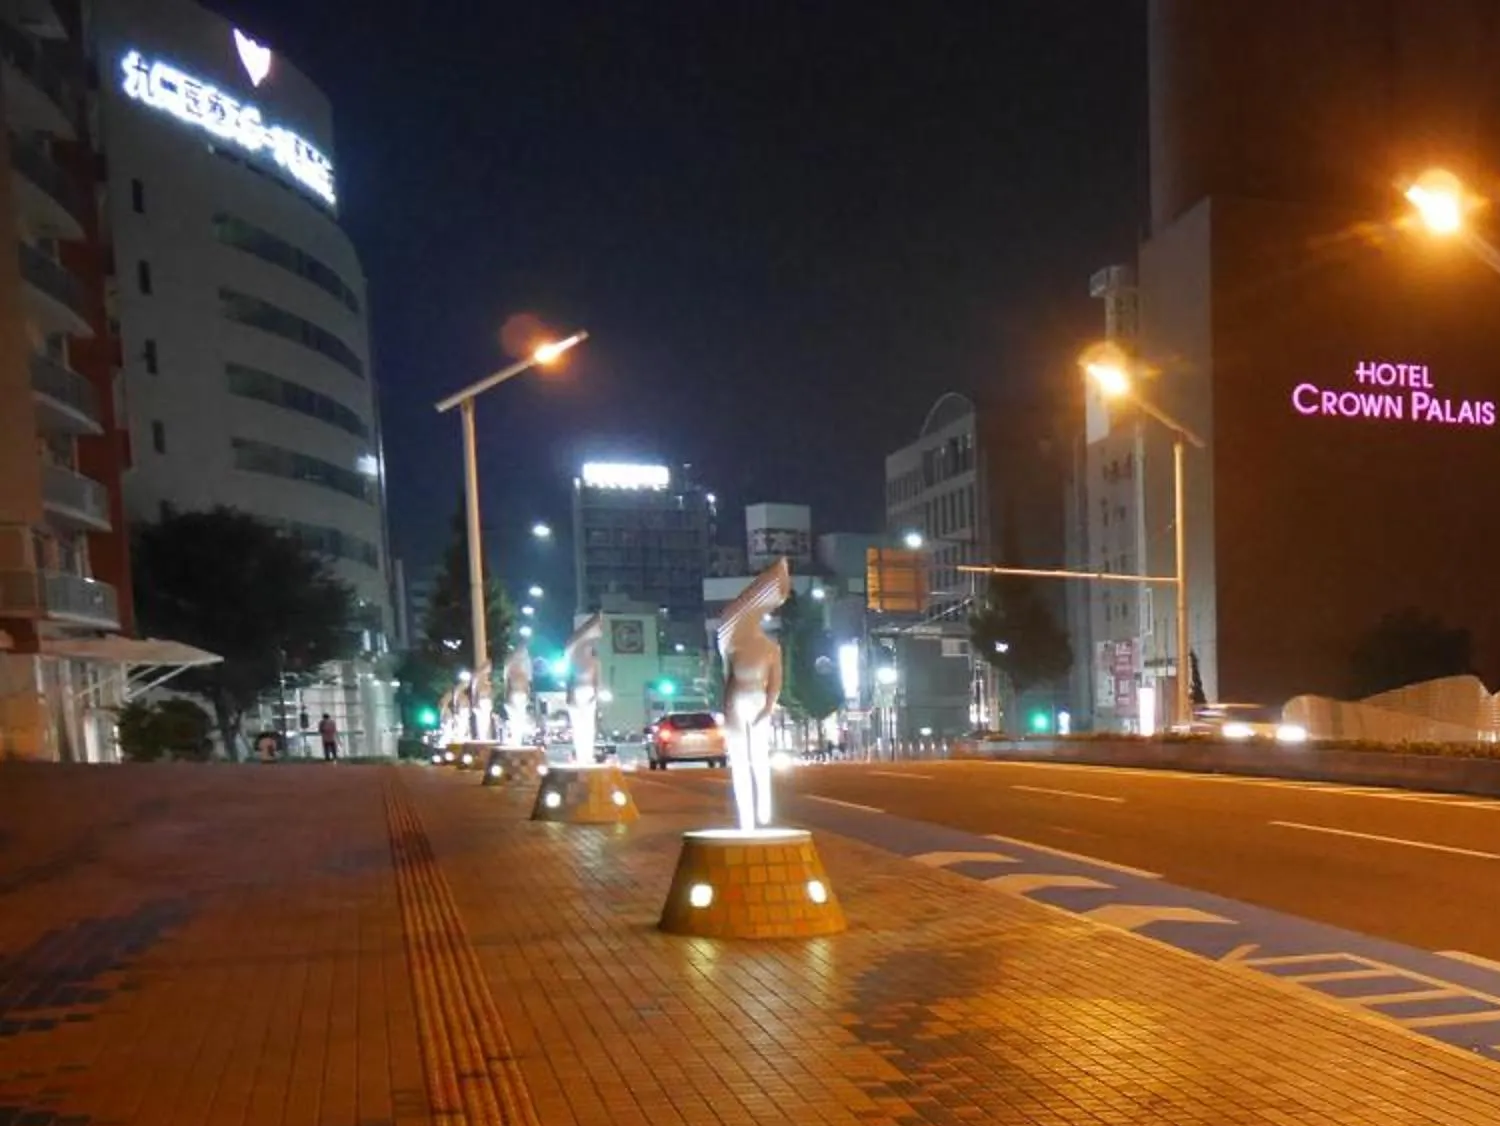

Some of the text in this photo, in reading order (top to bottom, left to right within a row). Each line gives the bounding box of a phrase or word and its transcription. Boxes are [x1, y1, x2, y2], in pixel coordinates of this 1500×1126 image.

[1355, 361, 1434, 389] HOTEL
[1292, 383, 1496, 425] CROWN PALAIS
